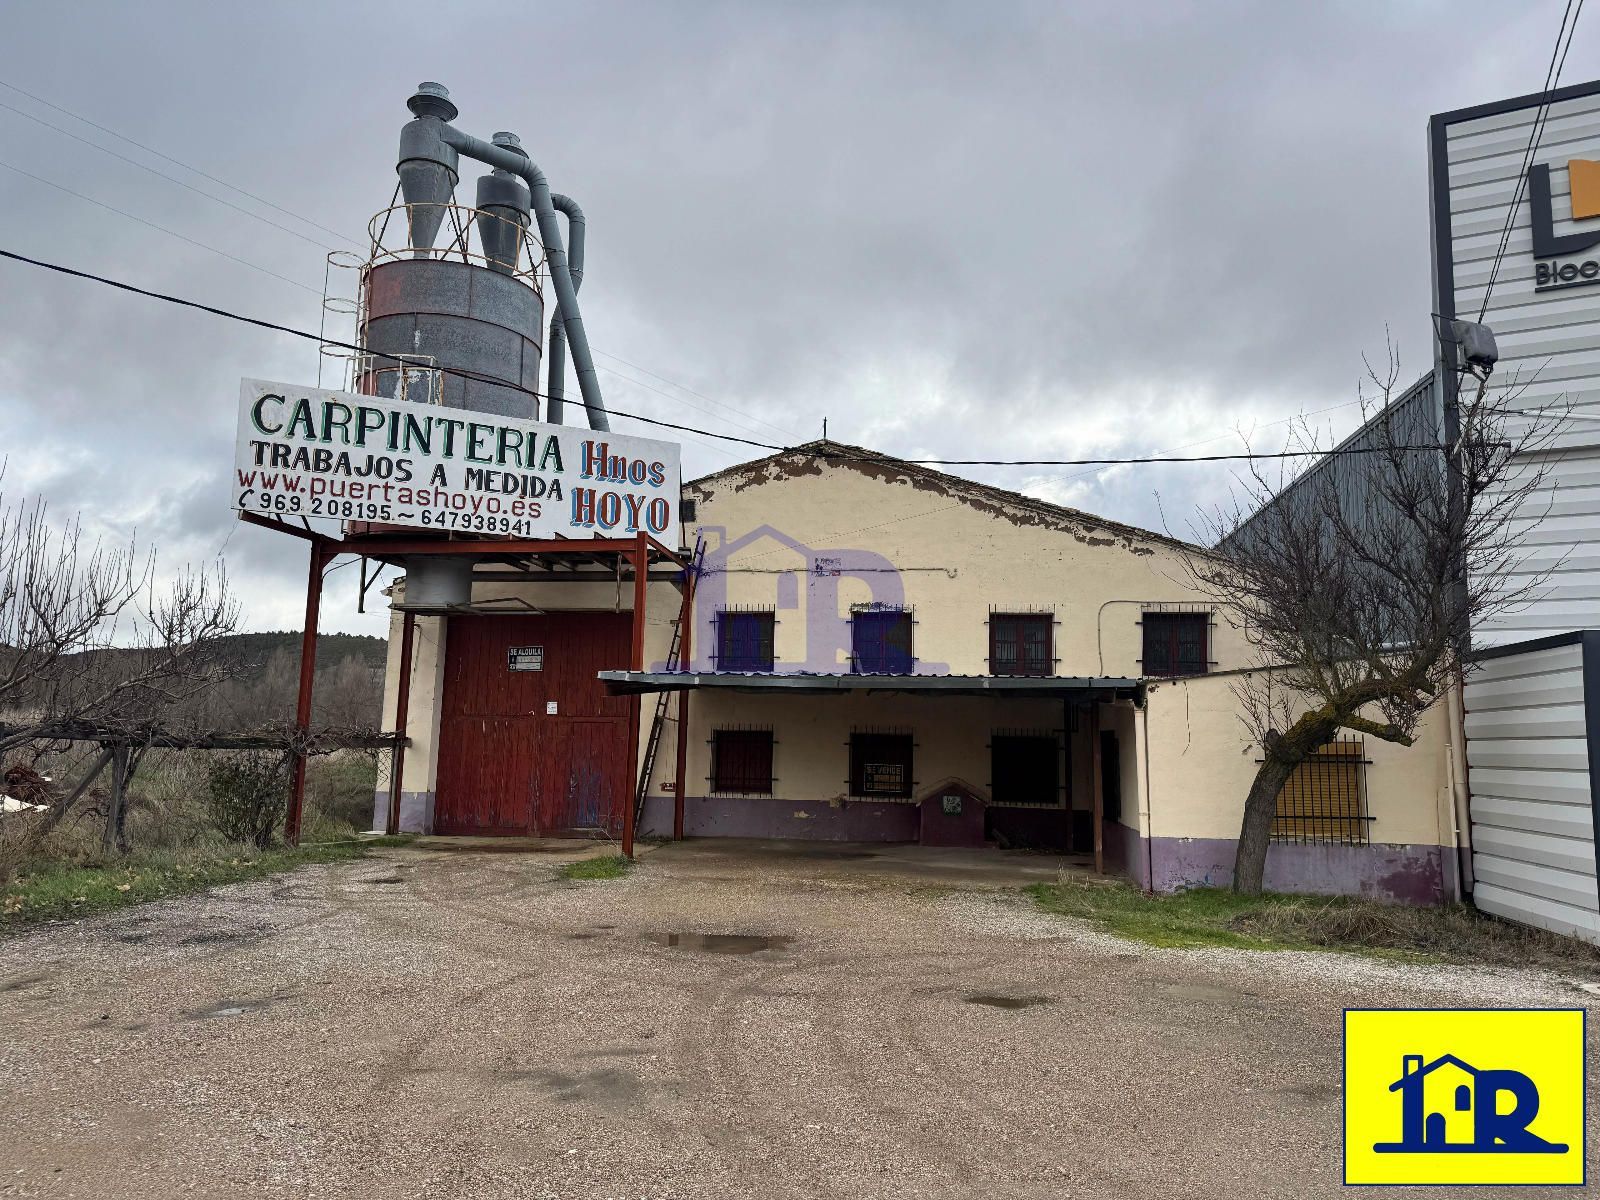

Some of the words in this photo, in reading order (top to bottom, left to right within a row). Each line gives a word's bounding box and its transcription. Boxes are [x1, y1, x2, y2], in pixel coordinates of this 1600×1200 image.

[250, 393, 564, 474] CARPINTERIA
[250, 440, 413, 483] TRABAJOS
[429, 463, 448, 487] A
[464, 467, 563, 502] MEDIDA
[580, 440, 666, 488] Hnos
[237, 468, 542, 520] www.puertashoyo.es
[570, 486, 670, 535] HOYO
[510, 648, 518, 656] SE
[867, 766, 877, 774] SE
